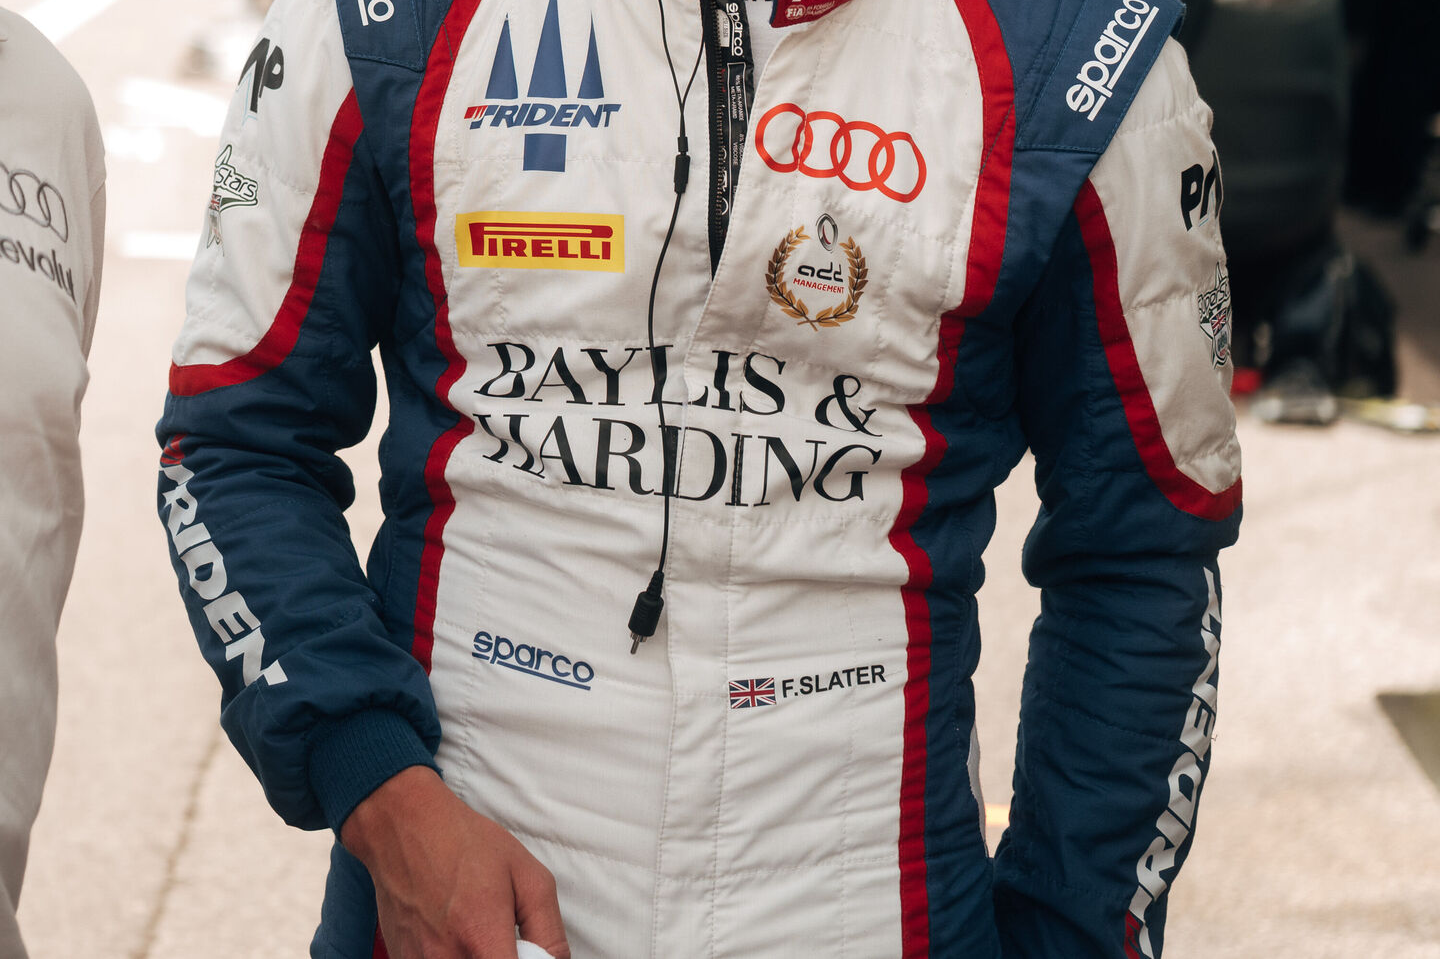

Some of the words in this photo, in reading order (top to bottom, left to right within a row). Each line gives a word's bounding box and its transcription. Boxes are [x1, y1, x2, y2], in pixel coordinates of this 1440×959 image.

[725, 2, 744, 57] sparco
[463, 103, 622, 130] TRIDENT
[468, 222, 614, 260] PIRELLI
[793, 277, 845, 294] MANAGEMENT
[473, 341, 786, 416] BAYLIS
[814, 374, 883, 438] &
[472, 413, 883, 508] HARDING
[471, 630, 595, 691] sparco
[781, 664, 887, 699] F.SLATER
